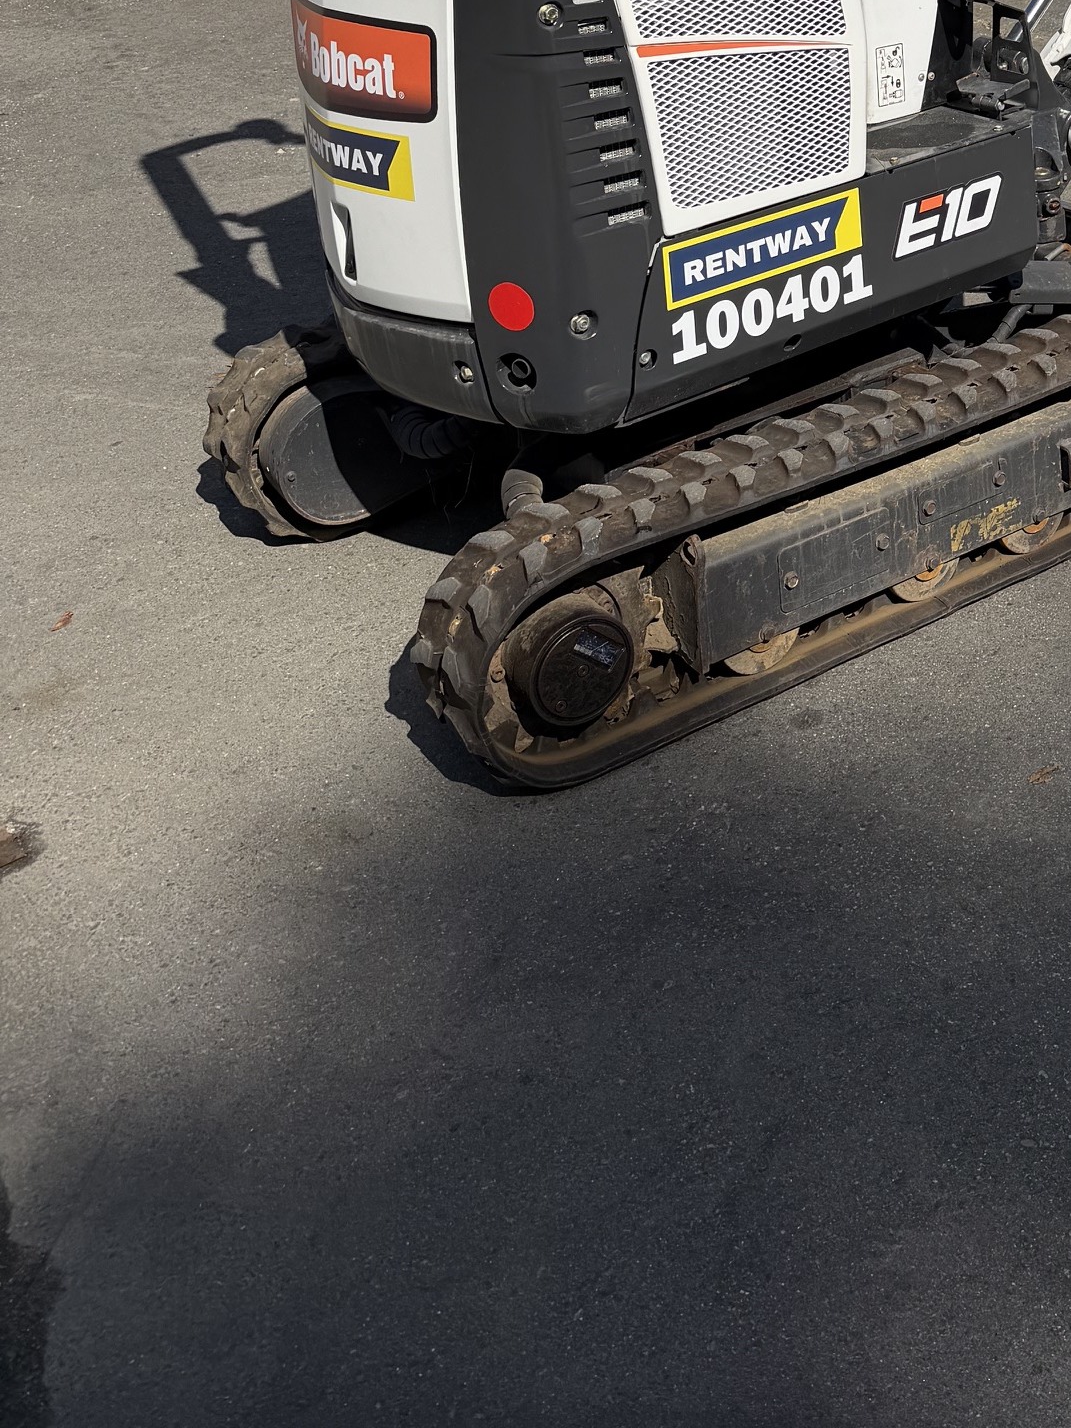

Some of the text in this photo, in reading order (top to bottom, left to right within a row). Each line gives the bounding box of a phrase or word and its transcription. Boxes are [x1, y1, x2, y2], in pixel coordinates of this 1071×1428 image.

[310, 32, 397, 99] Bobcat
[683, 217, 831, 286] RENTWAY
[895, 175, 1003, 259] E10
[671, 254, 874, 365] 100401
